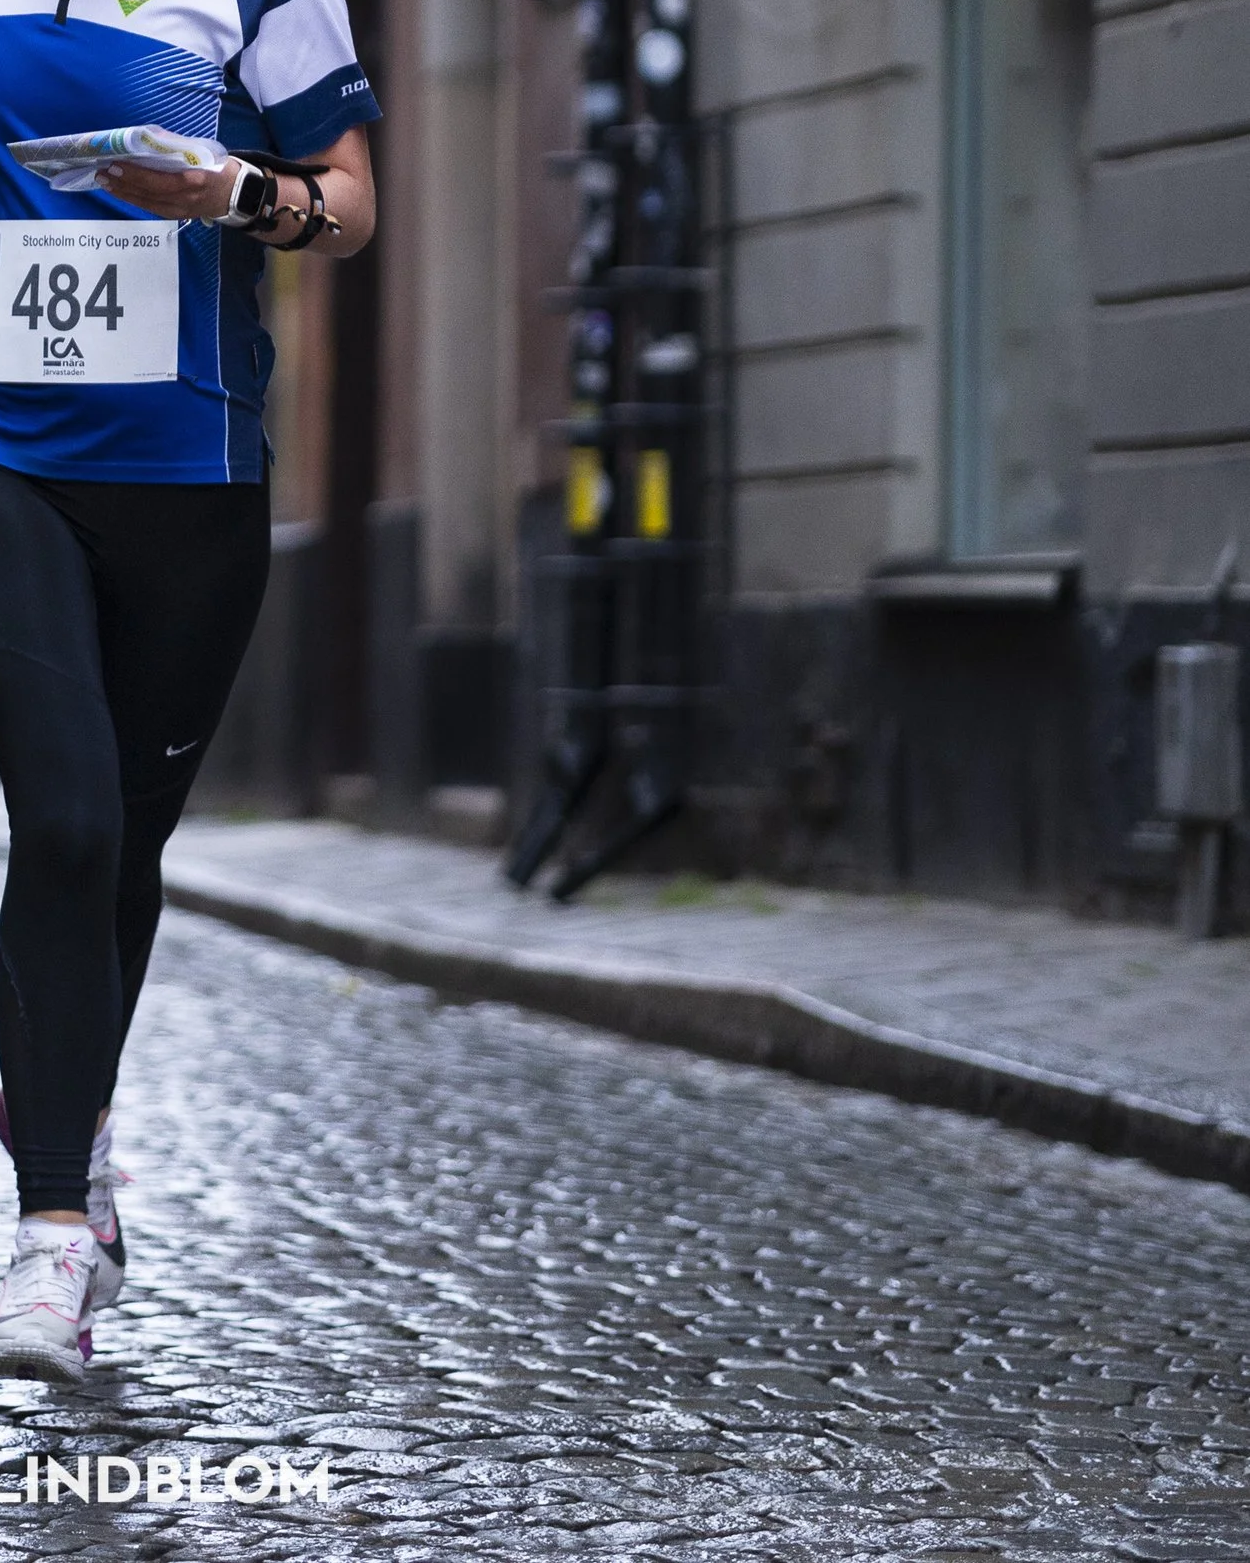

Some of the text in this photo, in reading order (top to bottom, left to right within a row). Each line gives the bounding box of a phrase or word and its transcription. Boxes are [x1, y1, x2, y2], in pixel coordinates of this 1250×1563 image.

[22, 234, 160, 250] Stockholm City Cup 2025
[11, 263, 124, 332] 484
[43, 336, 85, 359] ICA
[62, 357, 85, 367] nära
